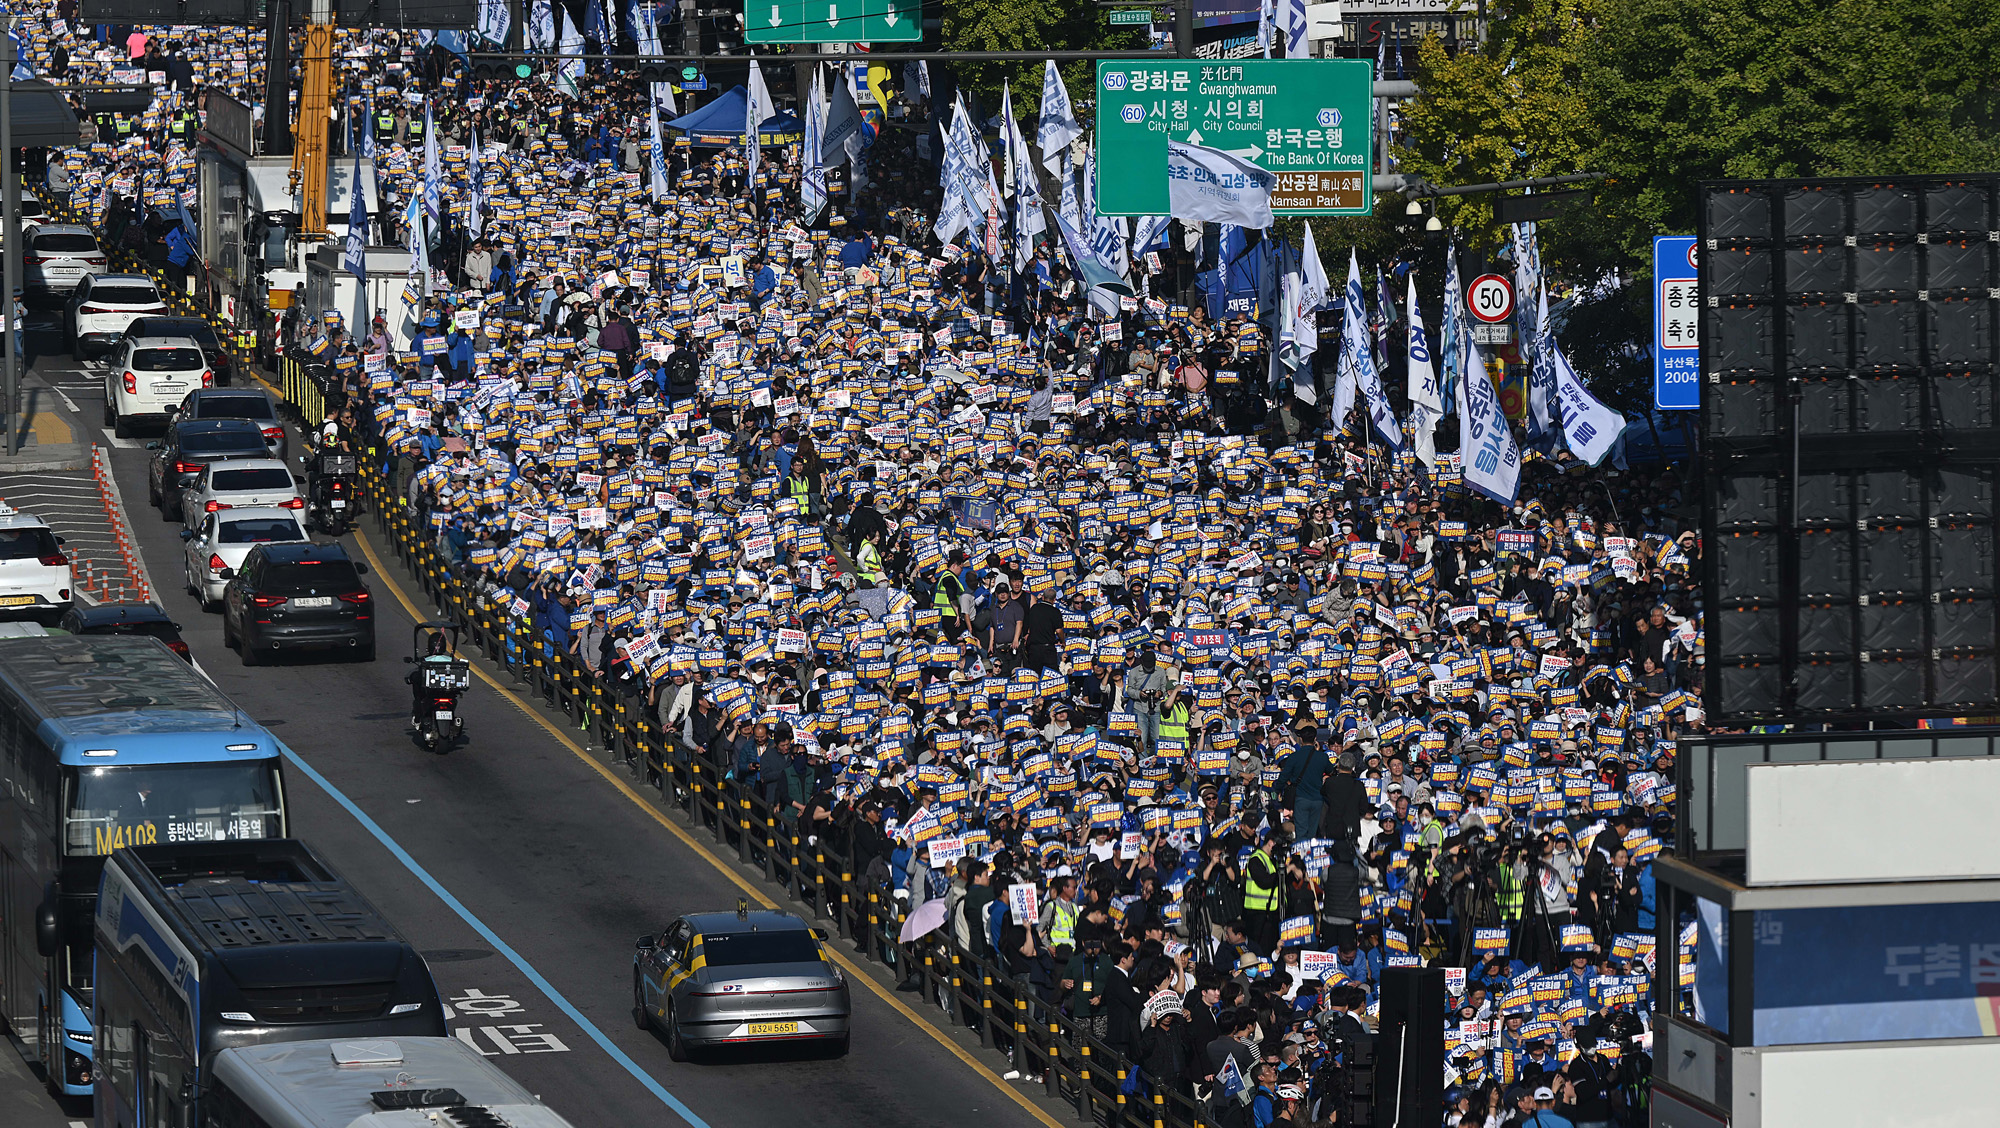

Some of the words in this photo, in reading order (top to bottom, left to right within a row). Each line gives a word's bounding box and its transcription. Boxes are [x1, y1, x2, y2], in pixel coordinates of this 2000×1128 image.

[1200, 66, 1243, 81] 光化門
[1108, 75, 1122, 87] 50
[1130, 70, 1191, 92] 광화문
[1198, 82, 1277, 97] Gwanghwamun
[1125, 108, 1141, 121] 60
[1322, 112, 1338, 124] 31
[1148, 120, 1168, 133] City
[1170, 120, 1189, 131] Hall
[1202, 120, 1223, 133] City
[1227, 120, 1263, 131] Council
[1265, 127, 1344, 149] 한국은행
[1266, 152, 1285, 165] The
[1288, 152, 1314, 165] Bank
[1317, 152, 1331, 165] Of
[1333, 152, 1364, 165] Korea
[1320, 177, 1362, 192] 南山公園
[1270, 195, 1312, 207] Namsan
[1316, 195, 1341, 207] Park
[1480, 287, 1503, 309] 50
[1225, 297, 1253, 312] 재명,
[748, 538, 769, 547] 국정농단
[799, 538, 821, 546] 김건희를
[594, 590, 617, 598] 김건희를
[630, 635, 651, 651] 국정농단
[1195, 634, 1221, 645] 주가조작
[742, 641, 763, 655] 김건희를
[1100, 647, 1123, 655] 김건희를
[1452, 658, 1476, 670] 김건희를
[714, 683, 739, 694] 김건희를
[925, 688, 949, 696] 김건희를
[1008, 683, 1033, 691] 김건희를
[1552, 688, 1575, 697] 김건희를
[842, 717, 865, 726] 김건희를
[1532, 722, 1558, 730] 김건희를
[1212, 733, 1236, 741] 김건희를
[1597, 727, 1622, 736] 김건희를
[1024, 754, 1048, 767] 김건희를
[1200, 752, 1226, 760] 김건희를
[940, 783, 964, 794] 김건희를
[1010, 785, 1035, 800] 김건희를
[1030, 808, 1056, 819] 김건희를
[1093, 804, 1119, 813] 김건희를
[1174, 811, 1199, 820] 김건희를
[167, 821, 213, 842] 동탄신도시
[227, 818, 262, 839] 서울역
[96, 824, 158, 855] M4108
[934, 840, 960, 850] 국정농단
[1281, 917, 1310, 930] 김건희를
[1476, 930, 1507, 938] 김건희를
[1563, 926, 1591, 934] 김건희를
[1305, 954, 1333, 962] 국정농단
[774, 1022, 795, 1033] 5651
[1520, 1020, 1551, 1033] 김건희를
